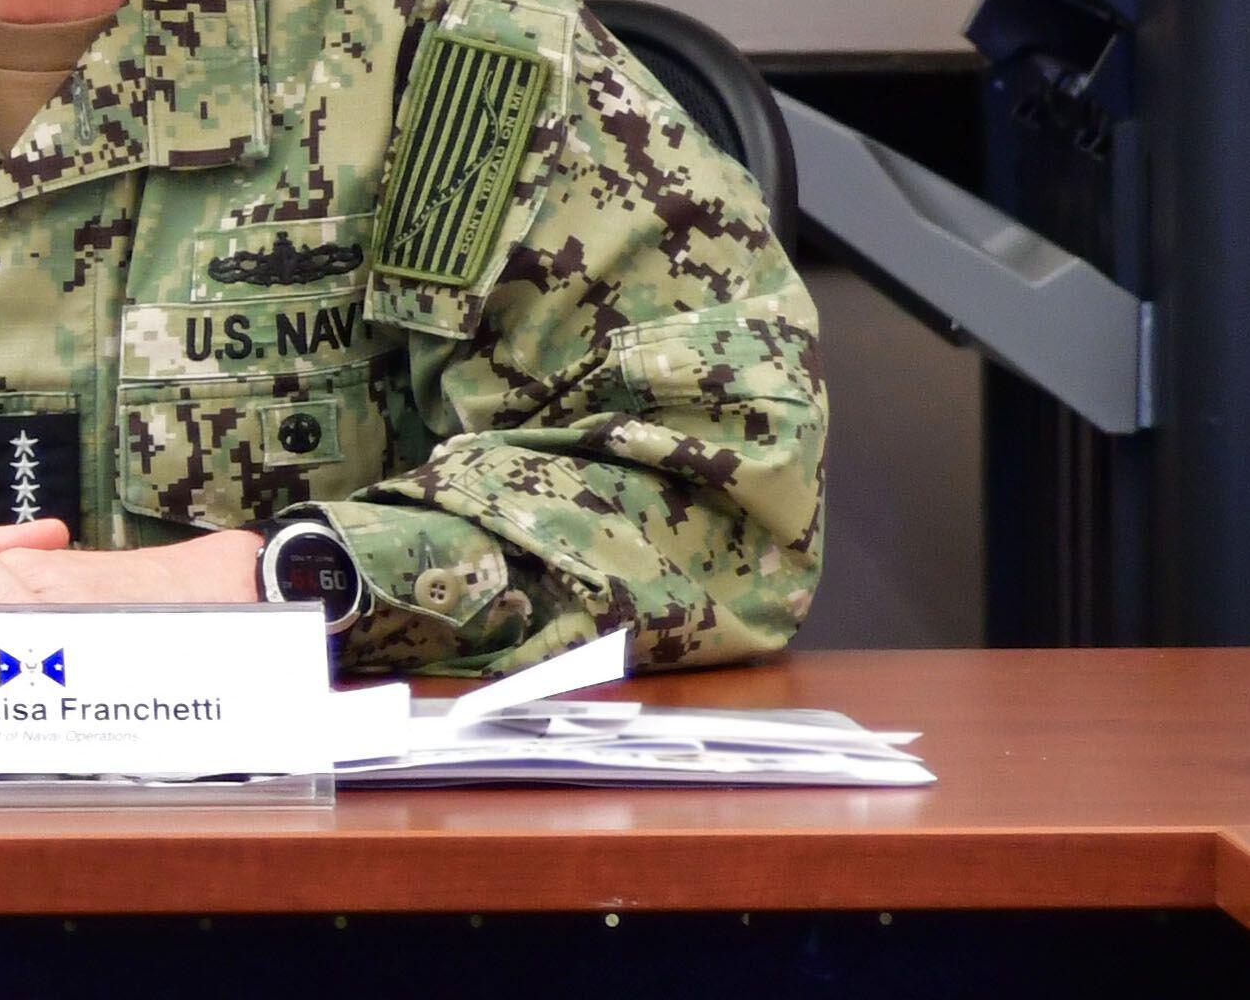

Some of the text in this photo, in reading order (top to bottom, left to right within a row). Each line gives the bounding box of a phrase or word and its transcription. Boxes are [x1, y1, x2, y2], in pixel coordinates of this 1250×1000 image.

[481, 145, 506, 200] TREAD
[502, 116, 518, 140] ON
[510, 86, 525, 111] ME
[186, 314, 264, 361] U.S.
[60, 697, 221, 720] Franchetti
[5, 729, 18, 743] of
[22, 729, 61, 743] Naval
[64, 729, 139, 743] Operations
